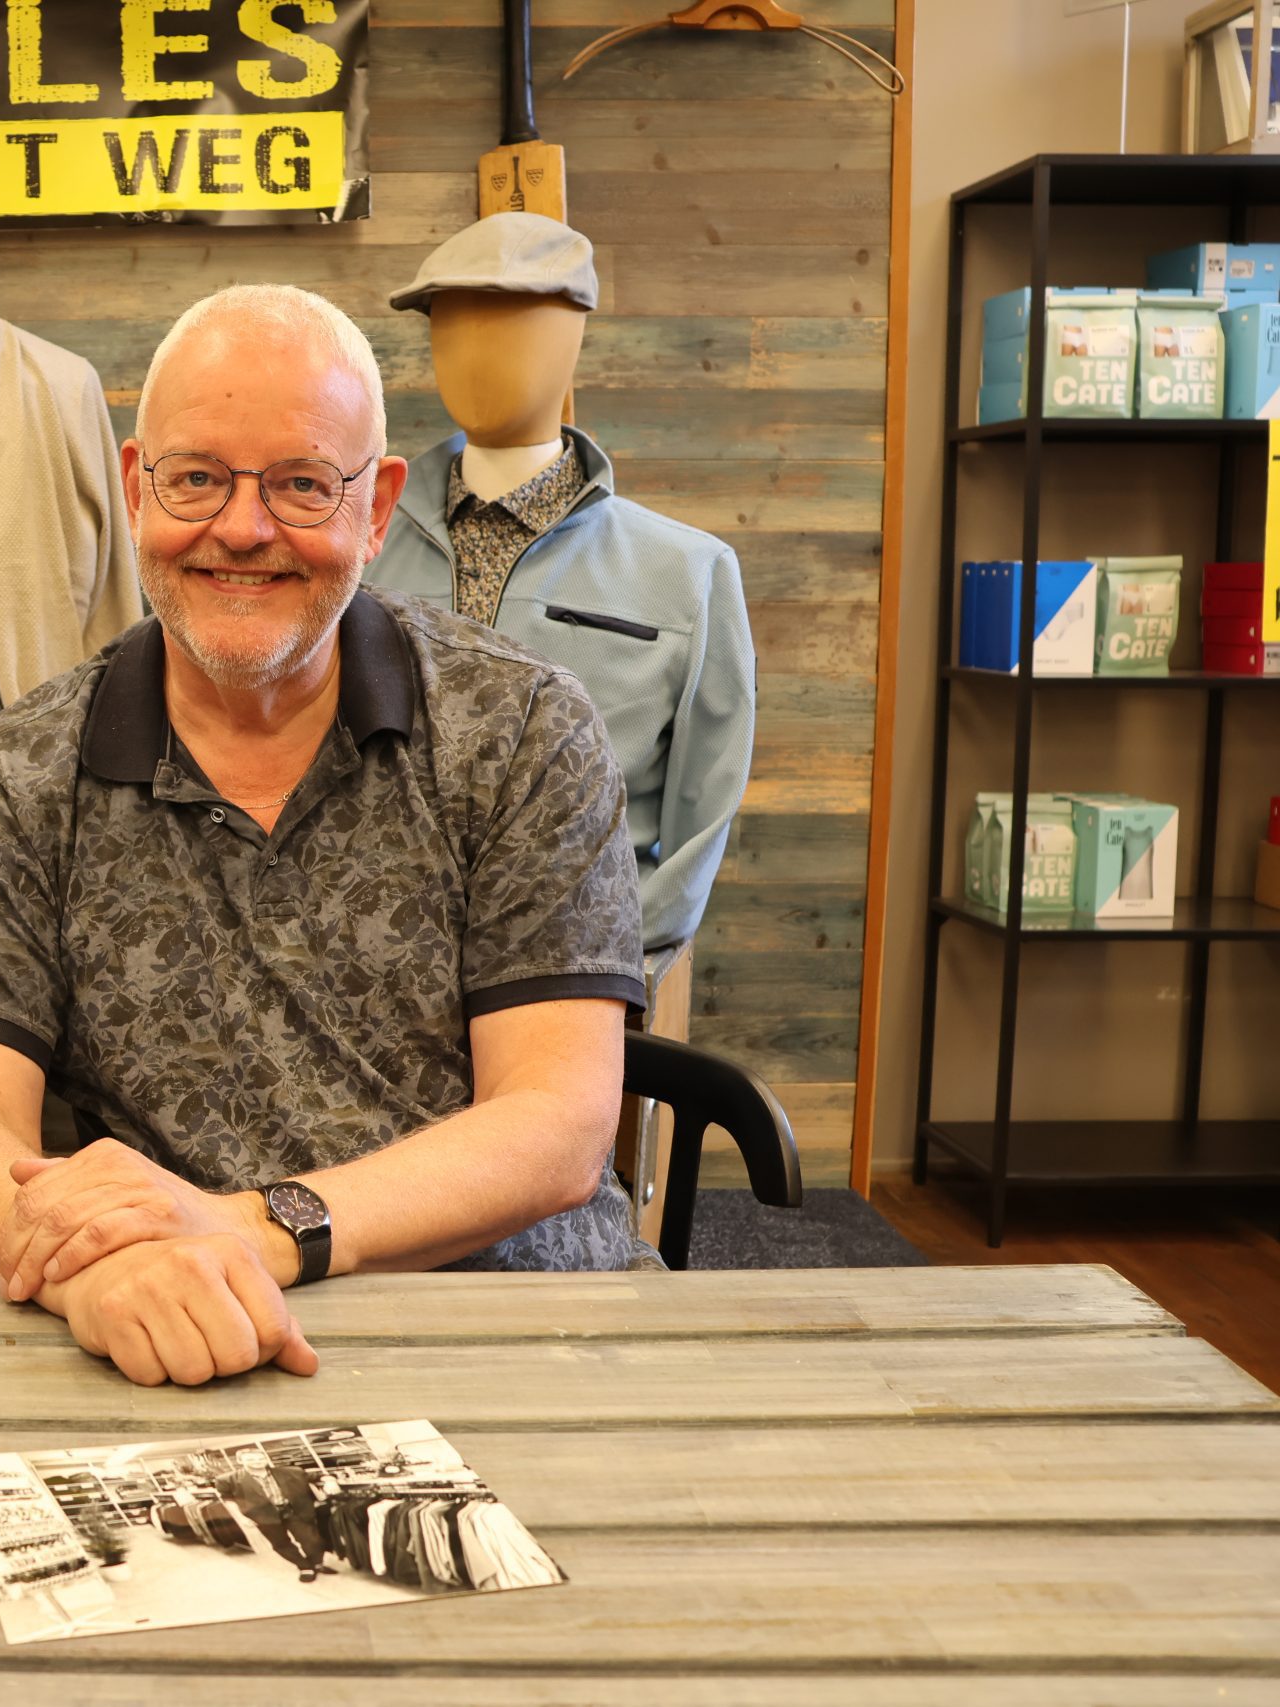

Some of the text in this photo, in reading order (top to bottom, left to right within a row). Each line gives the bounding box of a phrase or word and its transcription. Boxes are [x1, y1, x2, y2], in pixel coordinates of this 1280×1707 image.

[103, 126, 311, 196] WEG
[1080, 360, 1127, 381] TEN
[1172, 360, 1217, 381] TEN
[1054, 376, 1126, 406] CATE
[1148, 375, 1216, 405] CATE
[1134, 618, 1173, 637] TEN
[1109, 632, 1169, 660] CATE
[1030, 856, 1071, 876] TEN
[1023, 872, 1071, 897] ATE
